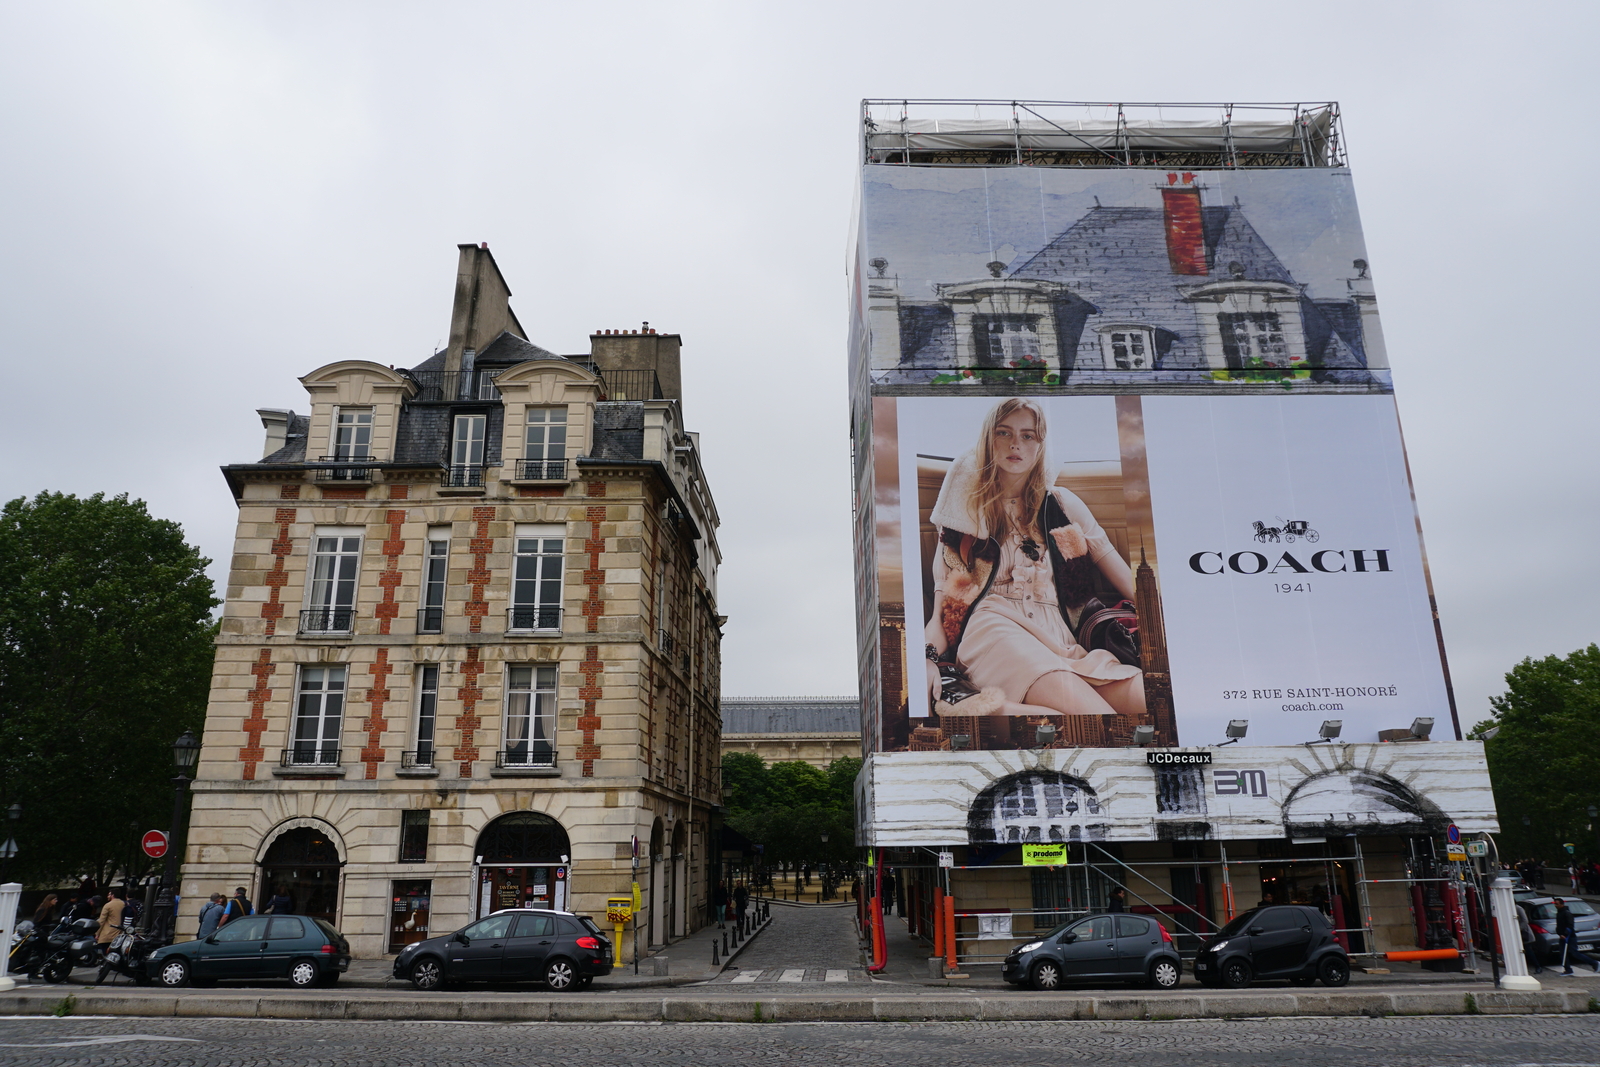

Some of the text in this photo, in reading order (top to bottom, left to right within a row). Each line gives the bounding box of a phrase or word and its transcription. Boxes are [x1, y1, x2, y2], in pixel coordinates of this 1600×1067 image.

[1189, 549, 1393, 575] COACH
[1274, 583, 1313, 594] 1941
[1223, 684, 1397, 700] 372 RUE SAINT-HONORÉ
[1281, 701, 1344, 712] coach.com
[1148, 753, 1211, 764] JCDecaux
[1033, 850, 1063, 858] prodomo
